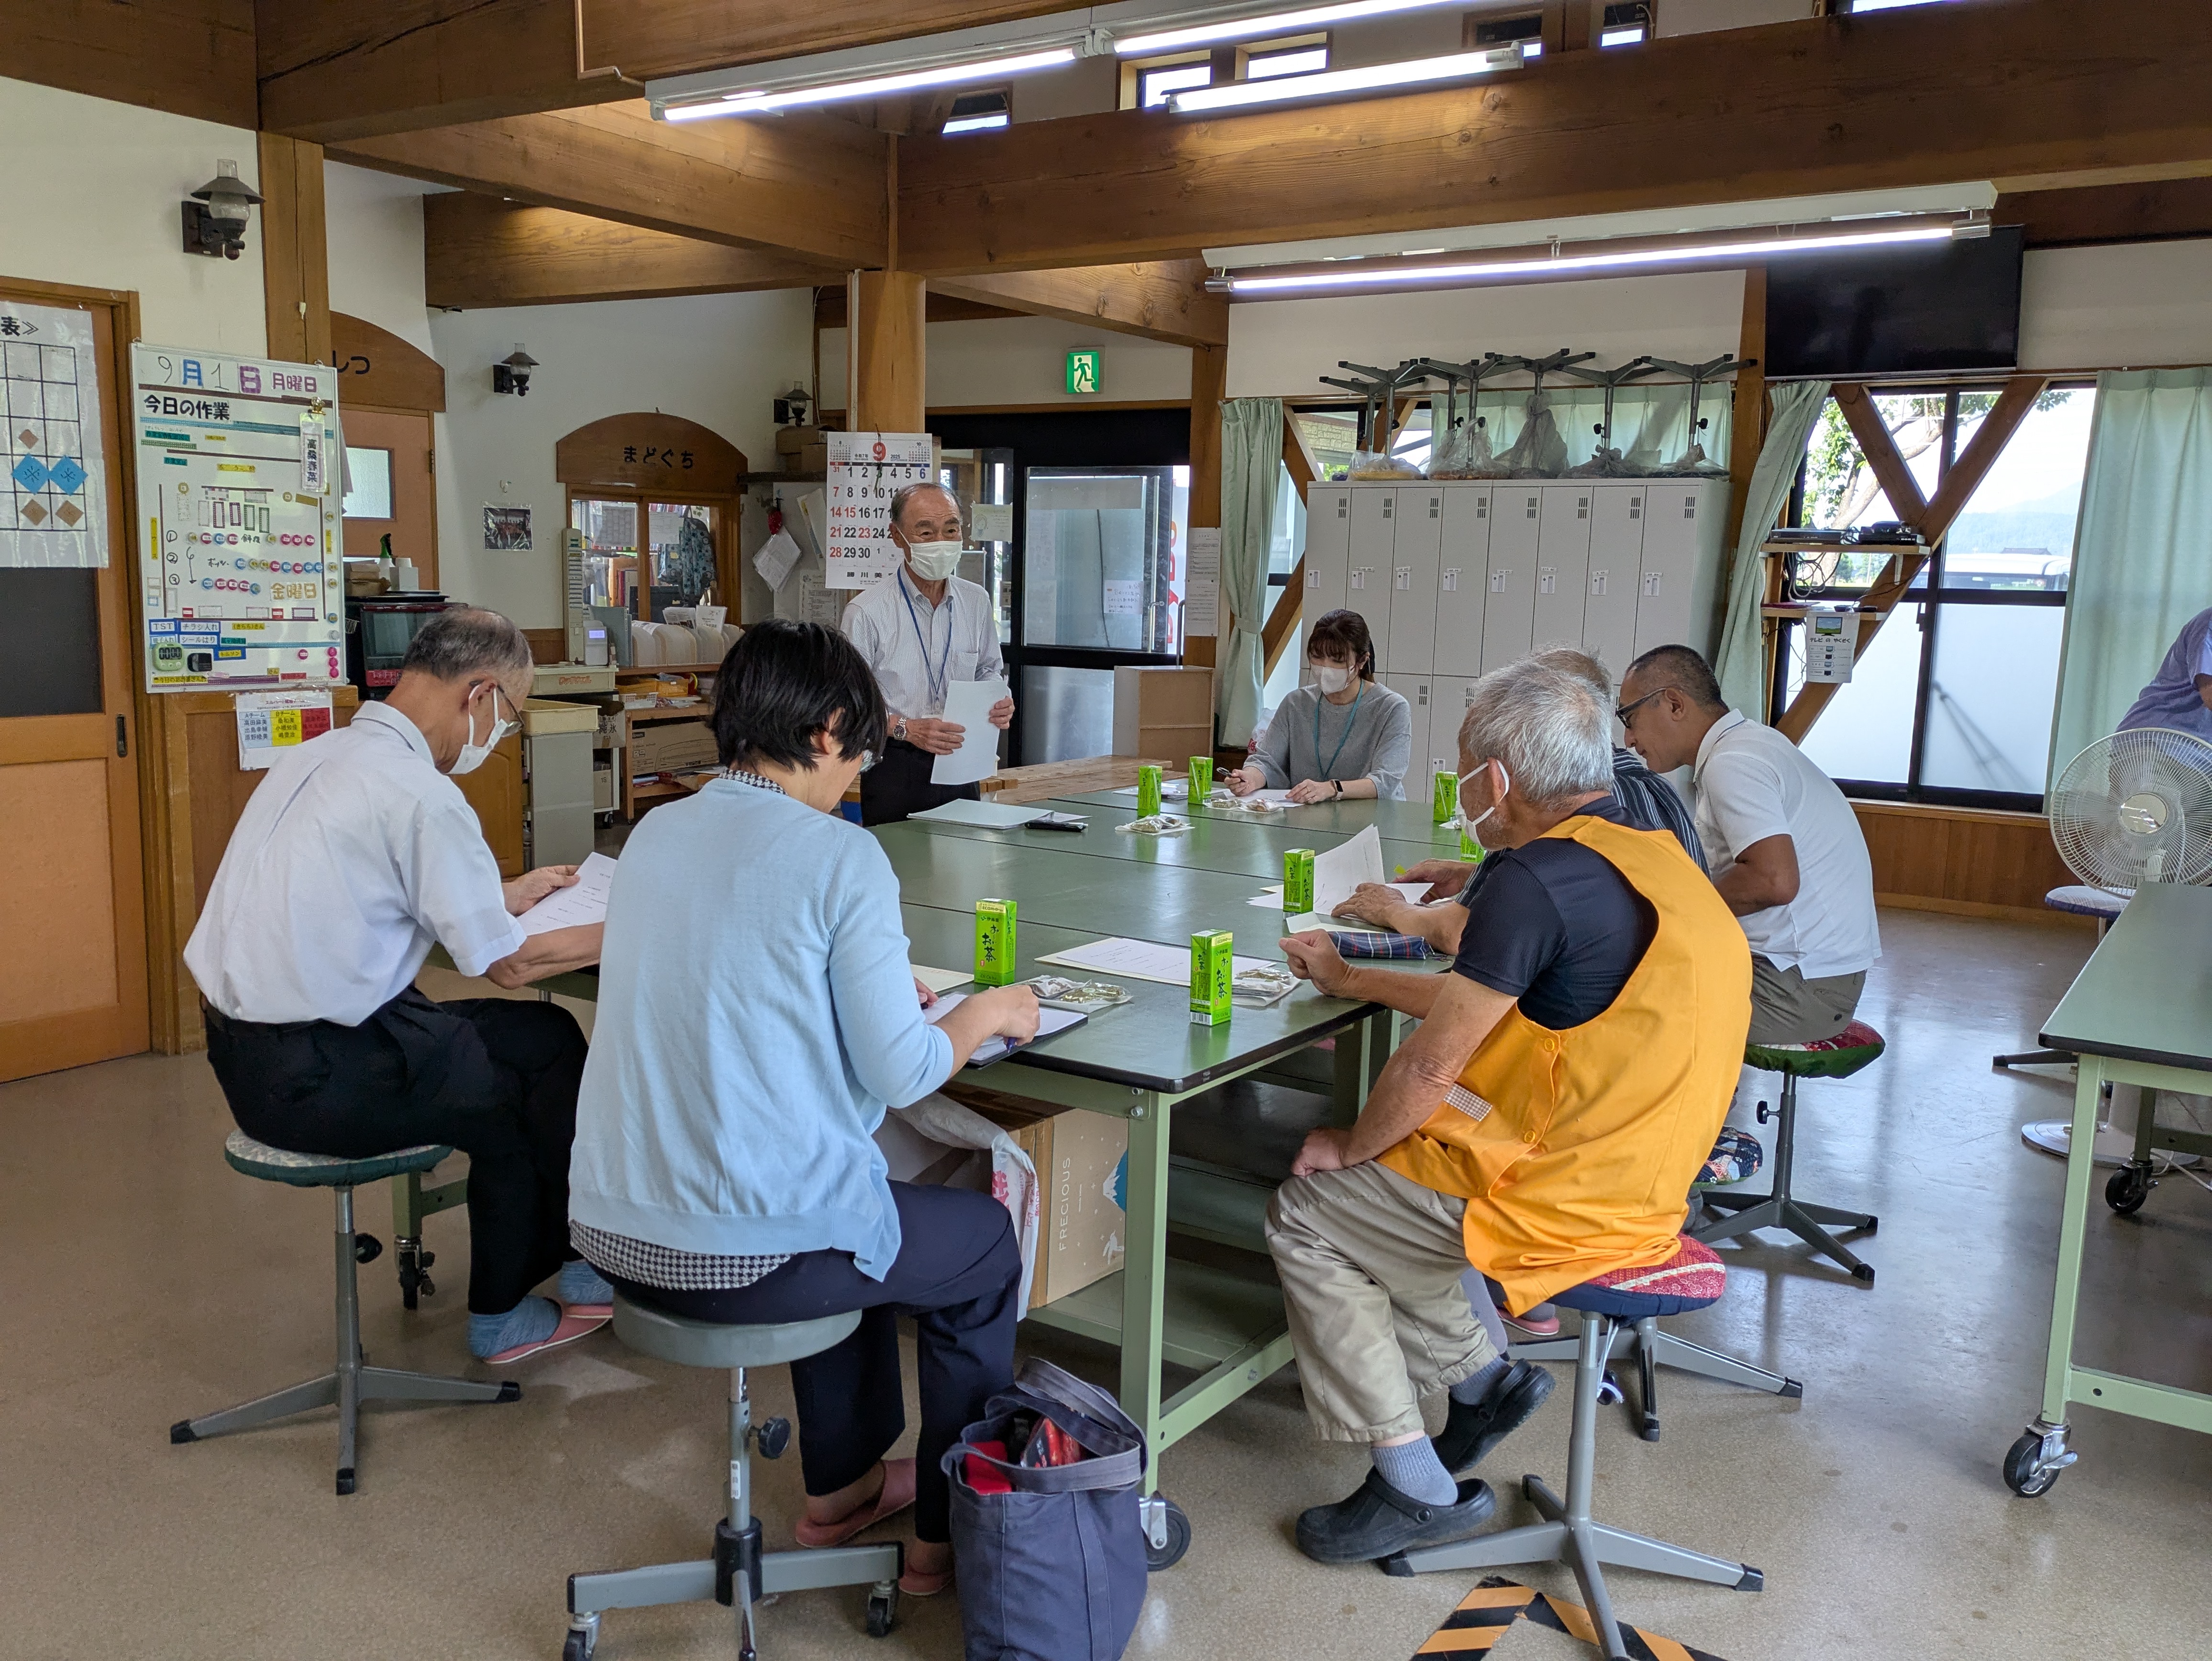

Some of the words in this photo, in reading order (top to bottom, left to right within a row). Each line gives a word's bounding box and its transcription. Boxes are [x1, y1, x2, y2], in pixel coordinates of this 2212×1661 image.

[272, 372, 317, 392] 月曜日
[144, 394, 230, 420] 今日の作業
[624, 446, 694, 469] まどぐち
[873, 442, 886, 462] 9
[848, 467, 852, 477] 1
[862, 467, 868, 478] 2
[890, 468, 897, 478] 4
[905, 468, 911, 478] 5
[920, 468, 926, 479] 6
[833, 487, 839, 498] 7
[847, 487, 853, 498] 8
[861, 487, 868, 498] 9
[874, 487, 885, 498] 10
[830, 507, 842, 518] 14
[844, 507, 856, 518] 15
[859, 507, 870, 518] 16
[873, 508, 885, 519] 17
[830, 526, 841, 538] 21
[844, 527, 856, 538] 22
[858, 527, 871, 539] 23
[873, 528, 885, 539] 24
[830, 547, 842, 557] 28
[844, 547, 856, 558] 29
[858, 547, 870, 558] 30
[271, 582, 317, 600] 金曜日
[1059, 1156, 1071, 1251] FRECIOUS
